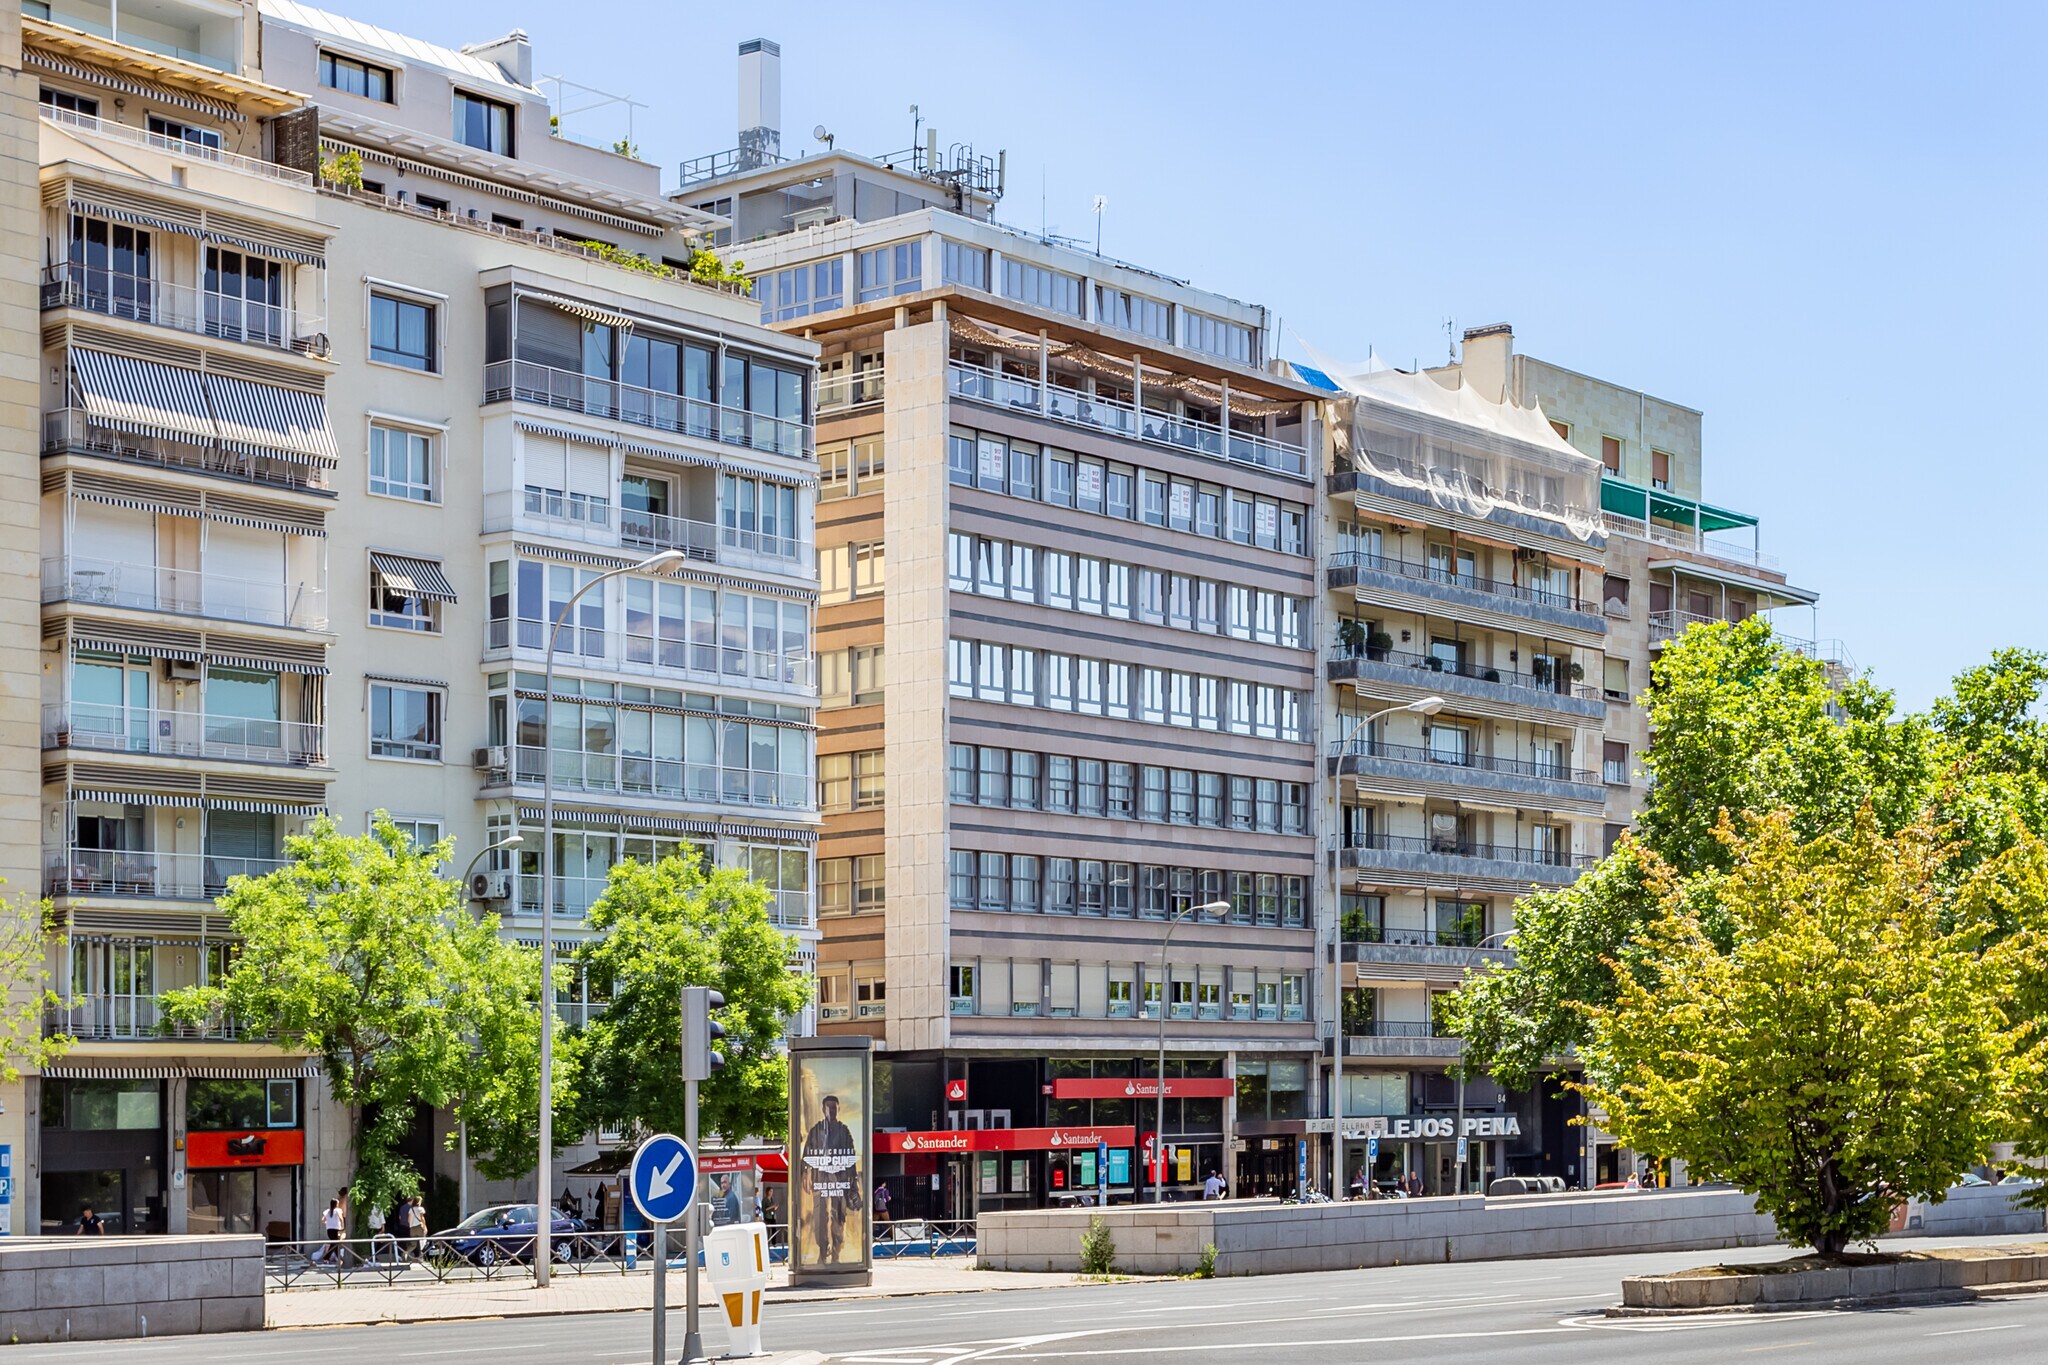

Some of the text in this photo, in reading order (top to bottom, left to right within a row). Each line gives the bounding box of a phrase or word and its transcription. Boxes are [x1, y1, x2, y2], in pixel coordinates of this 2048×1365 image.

[1136, 1083, 1172, 1095] Santaner
[1498, 1094, 1506, 1103] 84
[1321, 1121, 1369, 1131] CASELLANA
[1333, 1118, 1454, 1139] LEJOS
[917, 1135, 967, 1149] Santander
[1063, 1132, 1102, 1145] Santander
[1370, 1141, 1377, 1153] P
[815, 1156, 849, 1166] TOP GUN
